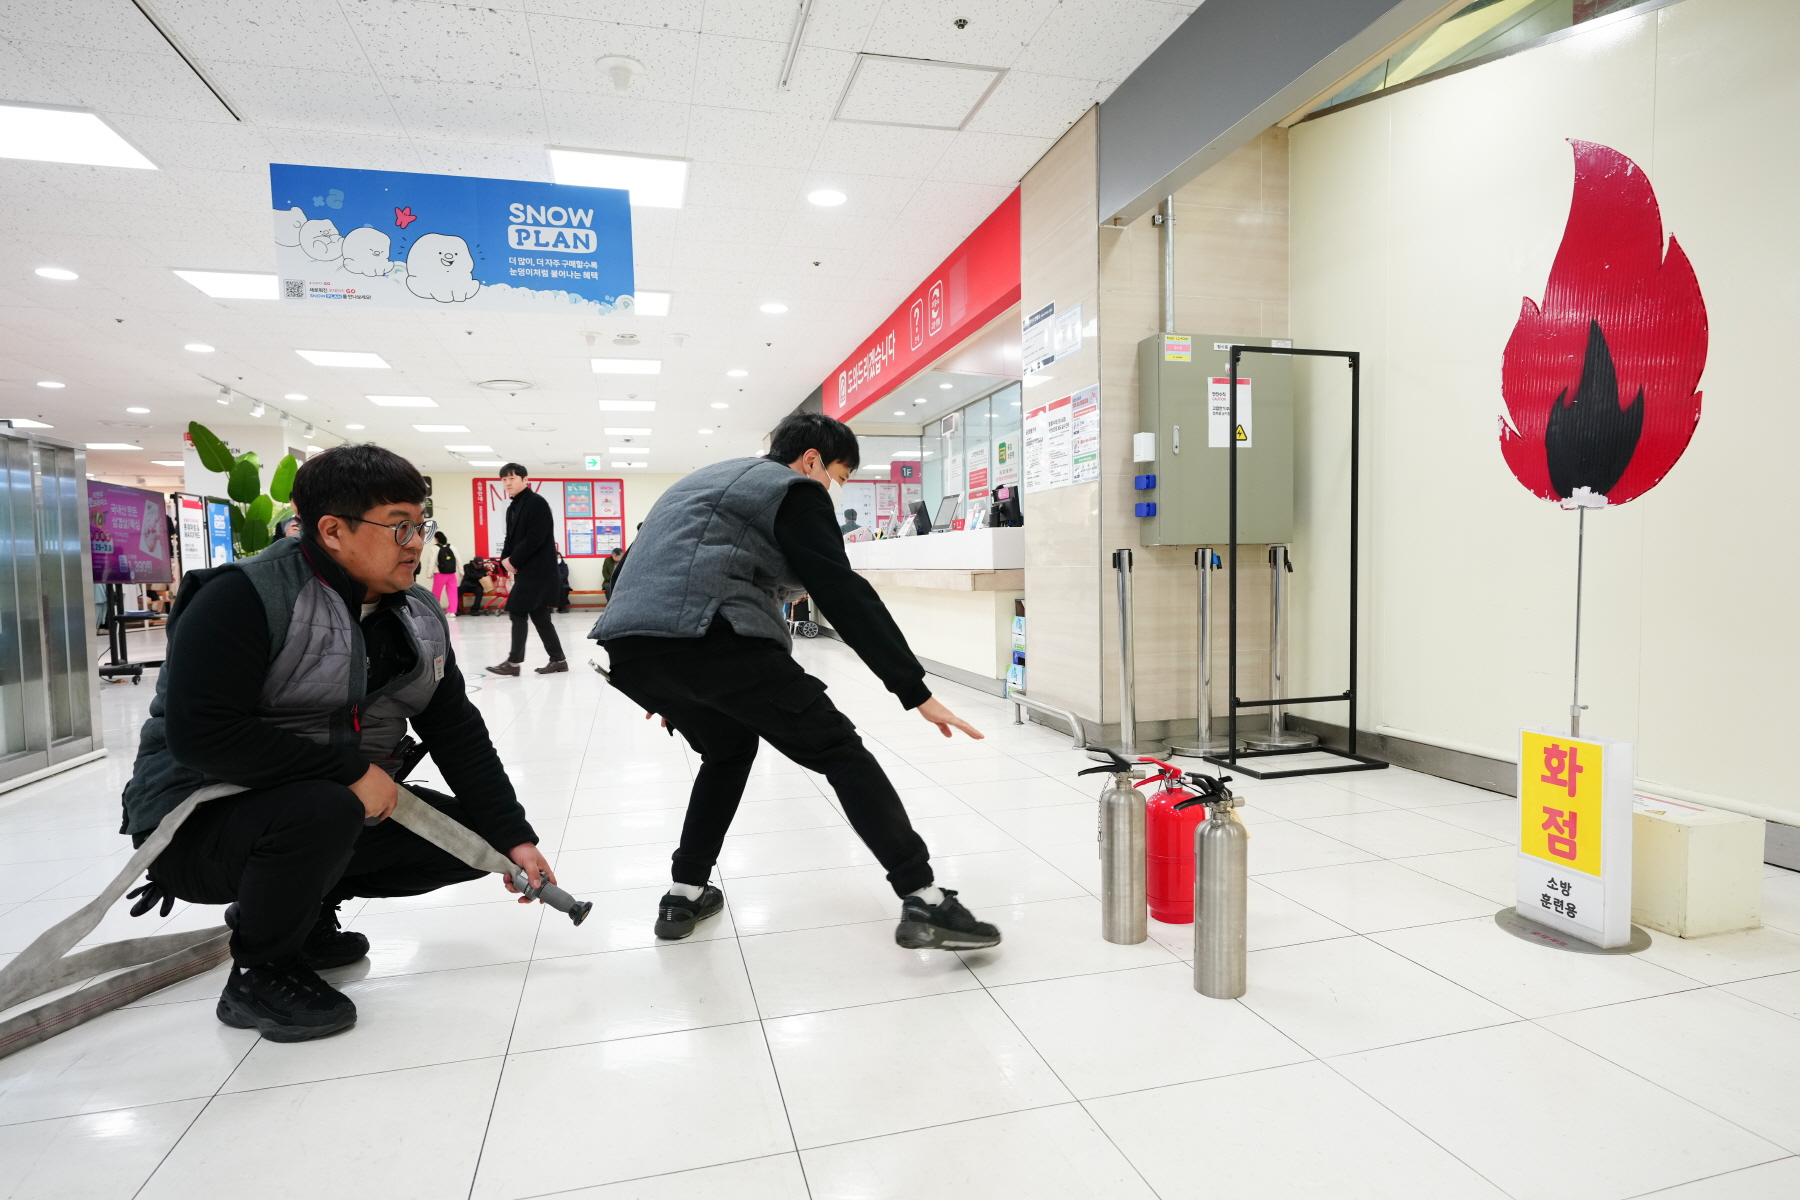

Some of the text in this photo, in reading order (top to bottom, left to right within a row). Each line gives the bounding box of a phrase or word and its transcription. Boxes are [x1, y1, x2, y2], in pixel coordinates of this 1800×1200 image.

[508, 202, 594, 228] SNOW
[514, 228, 590, 251] PLAN
[508, 256, 598, 269] 더 많이, 더 자주 구매할수록
[509, 268, 598, 280] 눈덩이처럼 불어나는 혜택
[848, 330, 896, 394] 도와드리겠습니다
[902, 468, 912, 476] 1F
[1540, 743, 1584, 862] 화점
[1546, 876, 1572, 897] 소방
[1540, 892, 1578, 920] 훈련용
